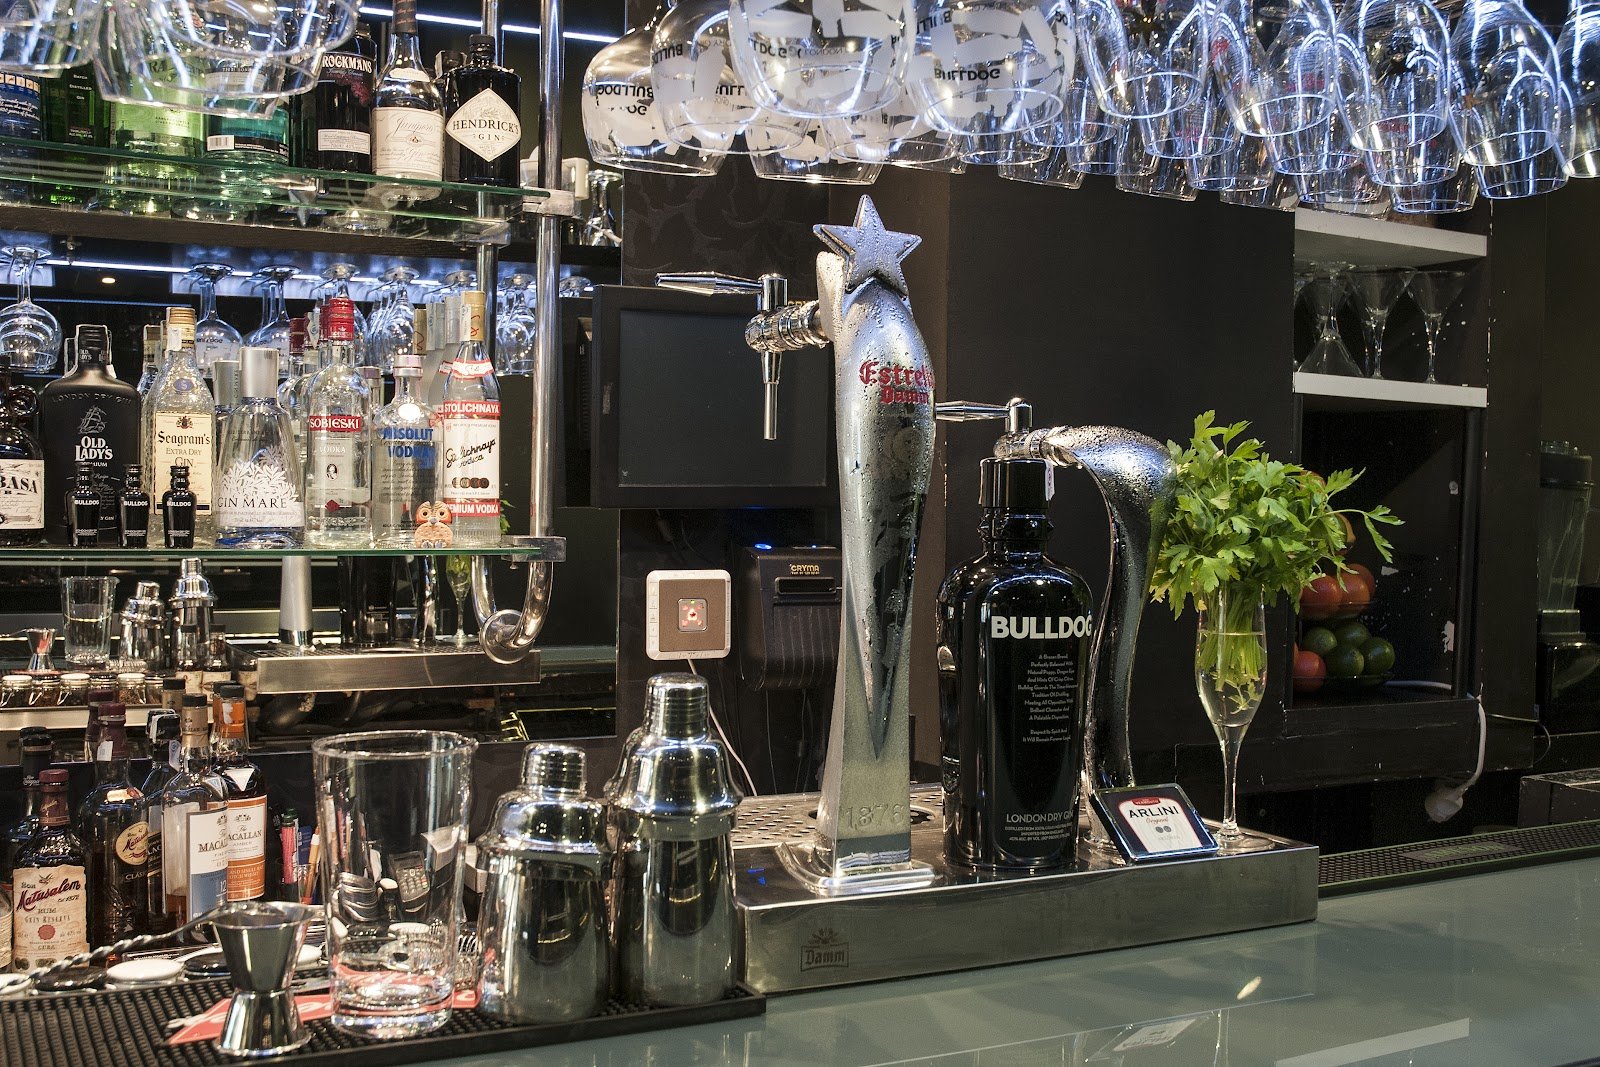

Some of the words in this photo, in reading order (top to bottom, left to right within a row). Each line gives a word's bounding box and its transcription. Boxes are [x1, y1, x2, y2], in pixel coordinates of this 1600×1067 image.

[651, 43, 684, 66] BULLD
[321, 55, 373, 74] ROCKMANS
[598, 84, 654, 98] BULLDOG
[452, 119, 519, 135] HENDRICK'S
[859, 358, 935, 390] Estrel
[444, 403, 500, 414] STOLICHNAYA
[309, 418, 359, 430] SOBIESKI
[158, 430, 211, 446] Seagram's
[166, 447, 187, 456] EXTRA
[188, 447, 202, 456] DRY
[0, 475, 38, 494] BASA
[217, 496, 238, 508] GIN
[242, 498, 288, 509] MARE
[448, 503, 475, 514] EMIUM
[476, 503, 499, 514] VODKA
[991, 614, 1092, 640] BULLDOG
[1006, 813, 1047, 823] LONDON
[1047, 811, 1064, 822] DRY
[1129, 805, 1179, 818] ARLINI
[227, 829, 262, 841] ACALLAN
[198, 839, 228, 853] MACAL
[125, 871, 145, 880] CLAS
[16, 878, 81, 912] Matusalem
[805, 949, 845, 965] Damm
